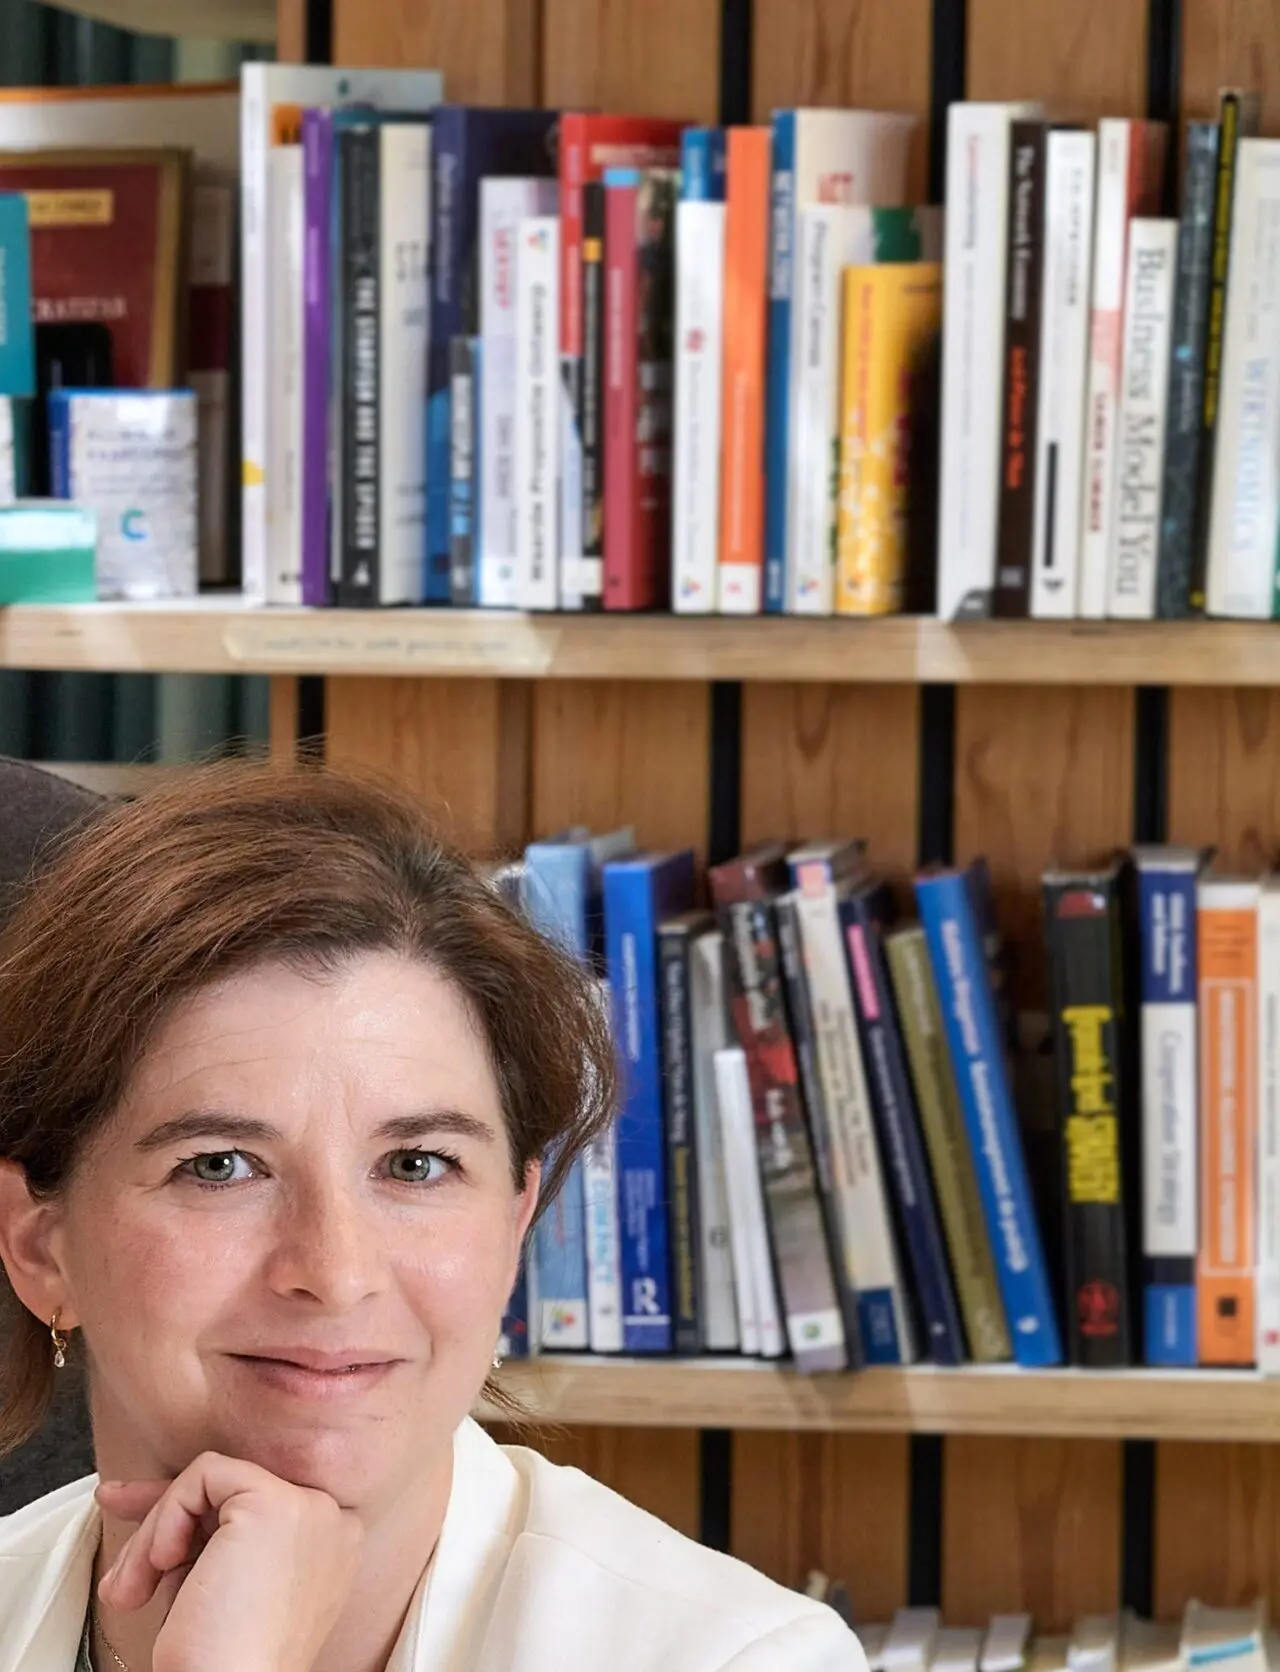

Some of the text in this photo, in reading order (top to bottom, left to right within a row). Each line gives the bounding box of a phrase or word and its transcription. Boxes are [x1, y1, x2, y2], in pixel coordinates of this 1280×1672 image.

[1010, 145, 1035, 320] The Network Economy
[355, 277, 376, 549] THE STARFISH AND THE SPIDER
[1114, 247, 1165, 597] Business Model You
[1235, 357, 1270, 552] WIKINOMICS
[1156, 1030, 1182, 1227] Cooperative Strategy
